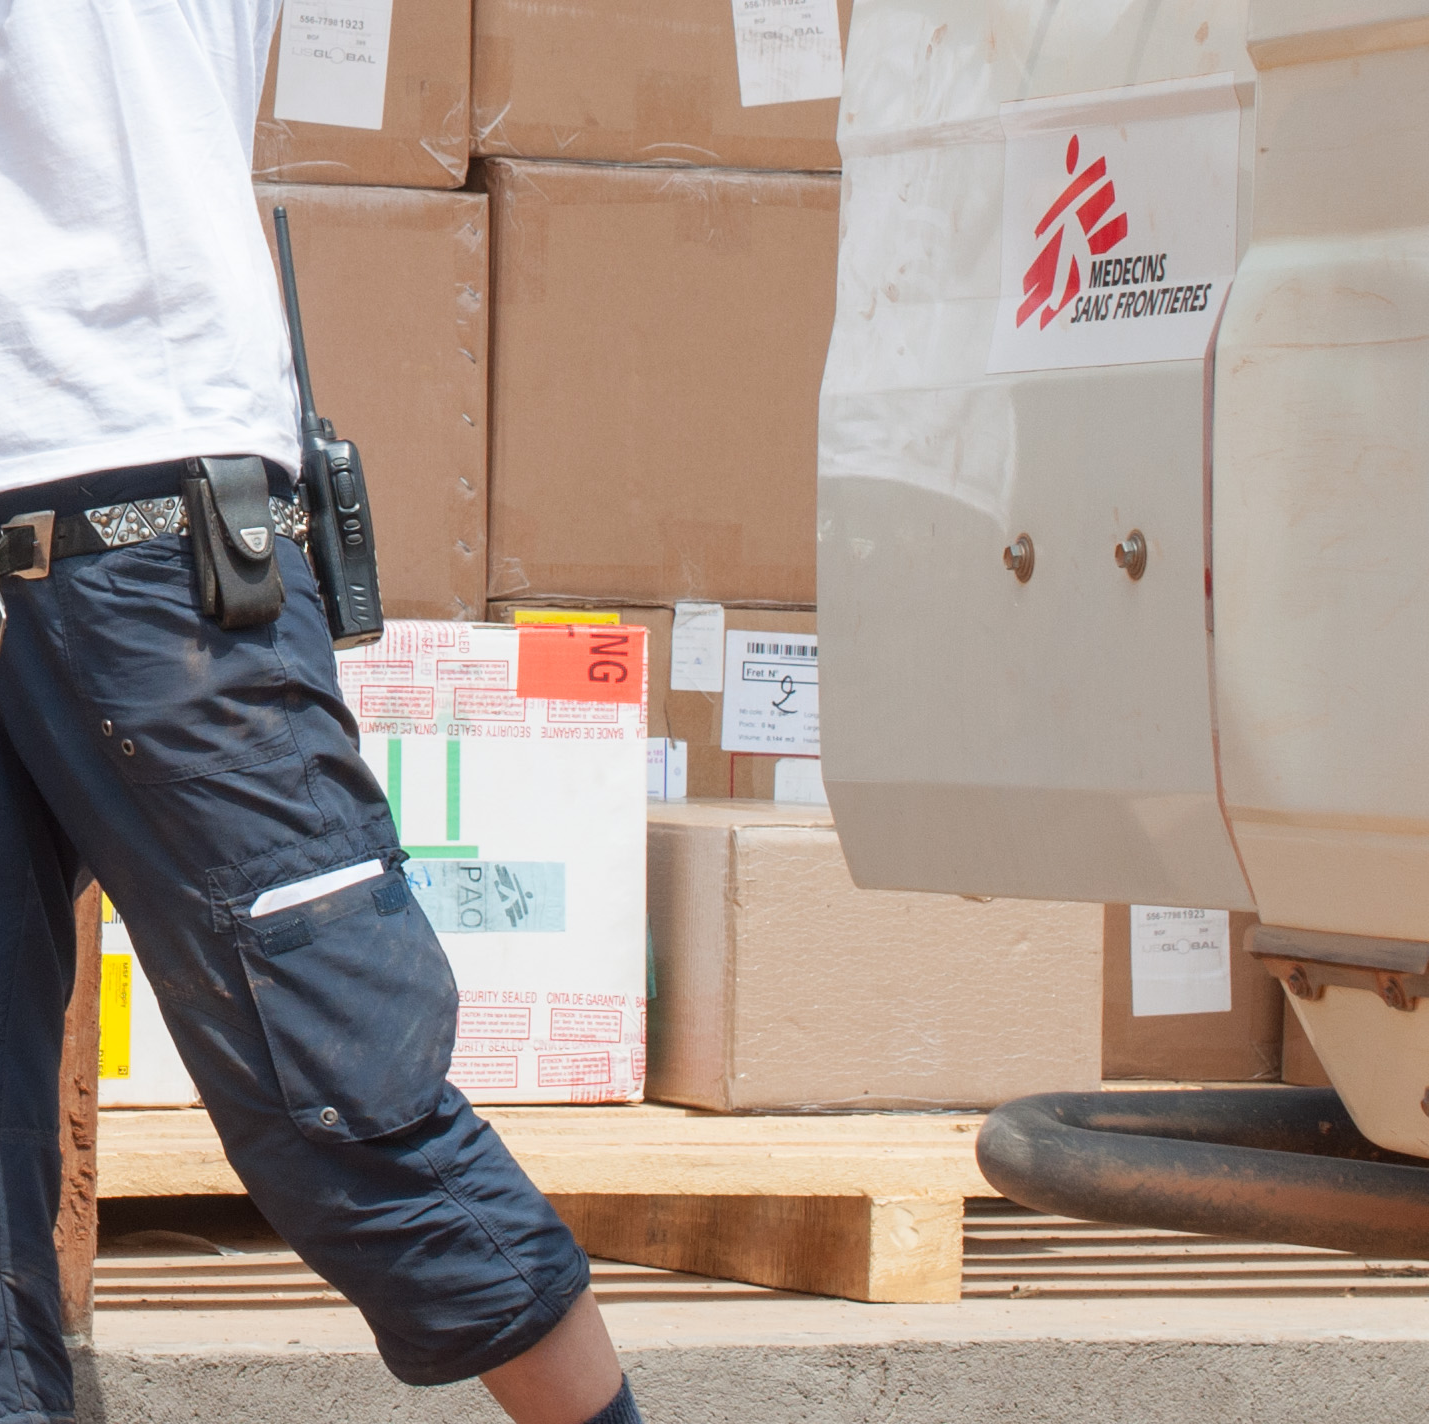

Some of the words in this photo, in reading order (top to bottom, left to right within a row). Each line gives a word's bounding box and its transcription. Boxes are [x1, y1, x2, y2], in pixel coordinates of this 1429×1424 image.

[1088, 253, 1168, 289] MEDECINS
[1070, 293, 1113, 324] SANS
[1113, 283, 1212, 320] FRONTIERES
[588, 633, 629, 684] NG
[746, 668, 765, 678] Fret
[414, 724, 439, 735] CINTA
[446, 724, 483, 737] SEALED
[485, 726, 532, 738] SECURITY
[540, 726, 582, 739] GARANTIE
[767, 722, 776, 730] kg
[582, 728, 596, 740] DE
[597, 728, 625, 740] BANDE
[459, 866, 484, 929] PAO
[501, 992, 538, 1004] SEALED
[546, 992, 572, 1005] CINTA
[572, 993, 584, 1005] DE
[585, 994, 627, 1007] GARANTIA
